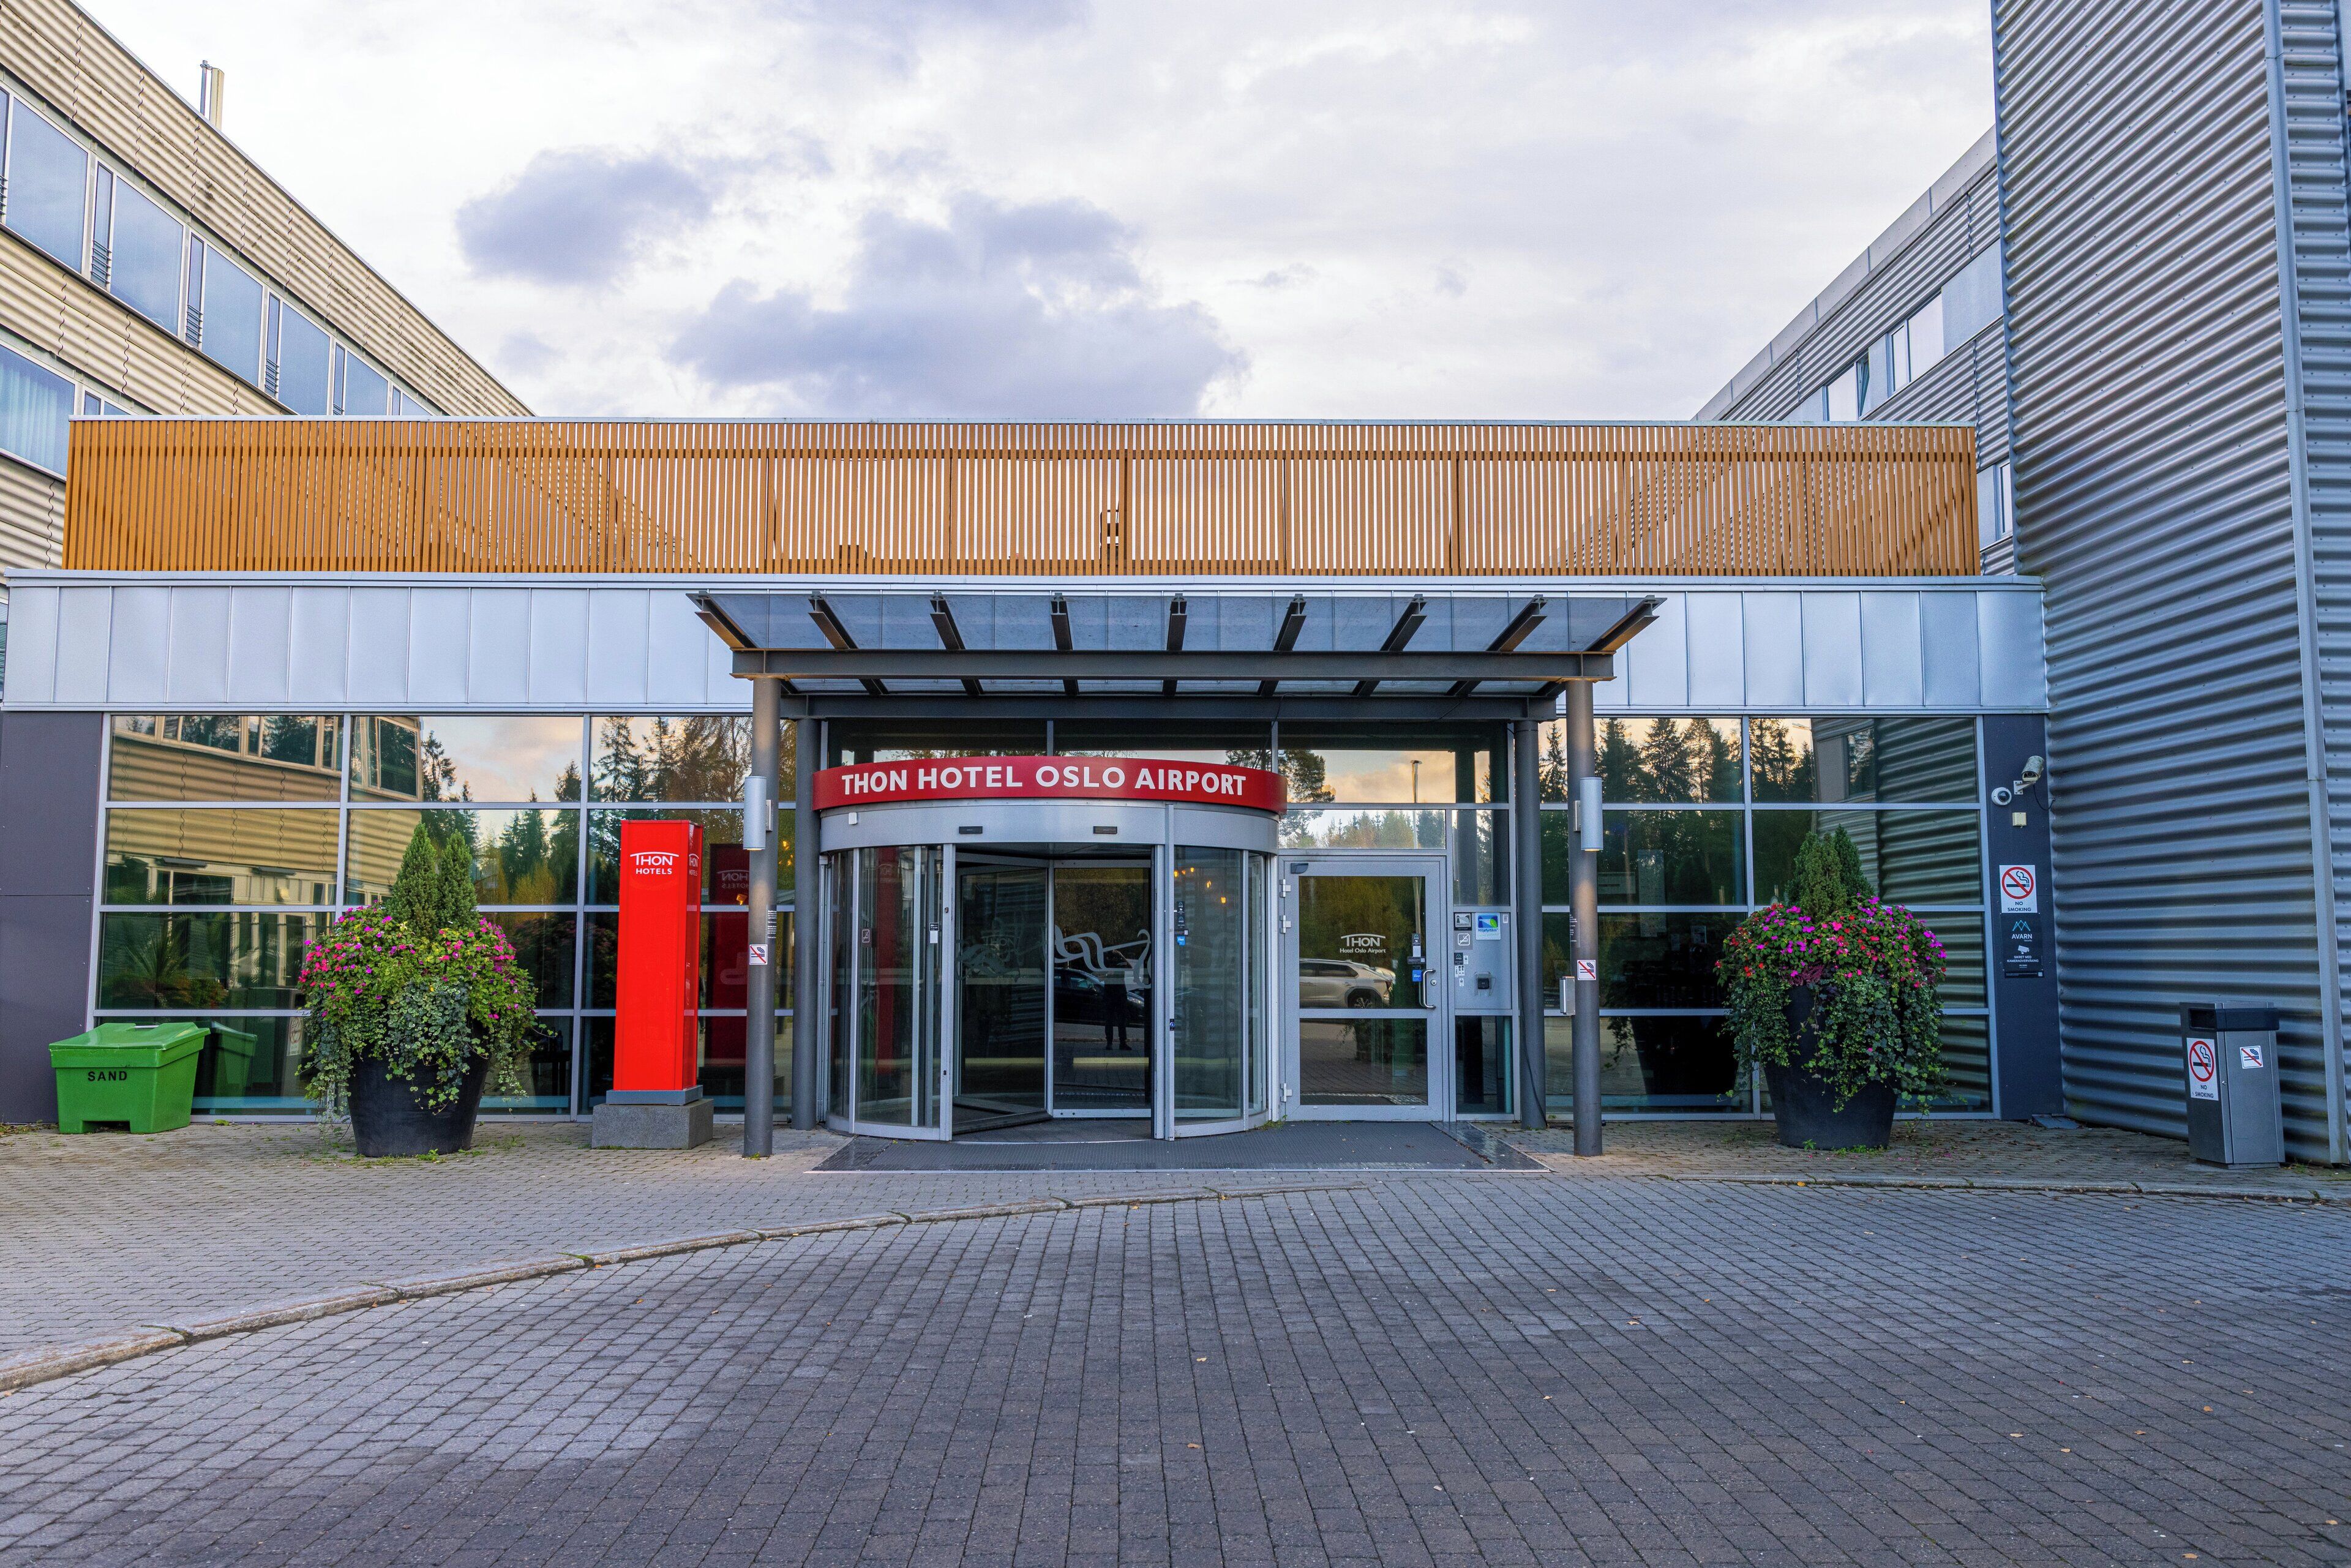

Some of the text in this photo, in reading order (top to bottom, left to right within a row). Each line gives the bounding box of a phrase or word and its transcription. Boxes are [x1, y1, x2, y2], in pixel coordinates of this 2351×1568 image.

[842, 765, 1247, 796] THON HOTEL OSLO AIRPORT
[630, 851, 679, 866] THON
[1341, 933, 1385, 947] THON
[88, 1071, 127, 1082] SAND
